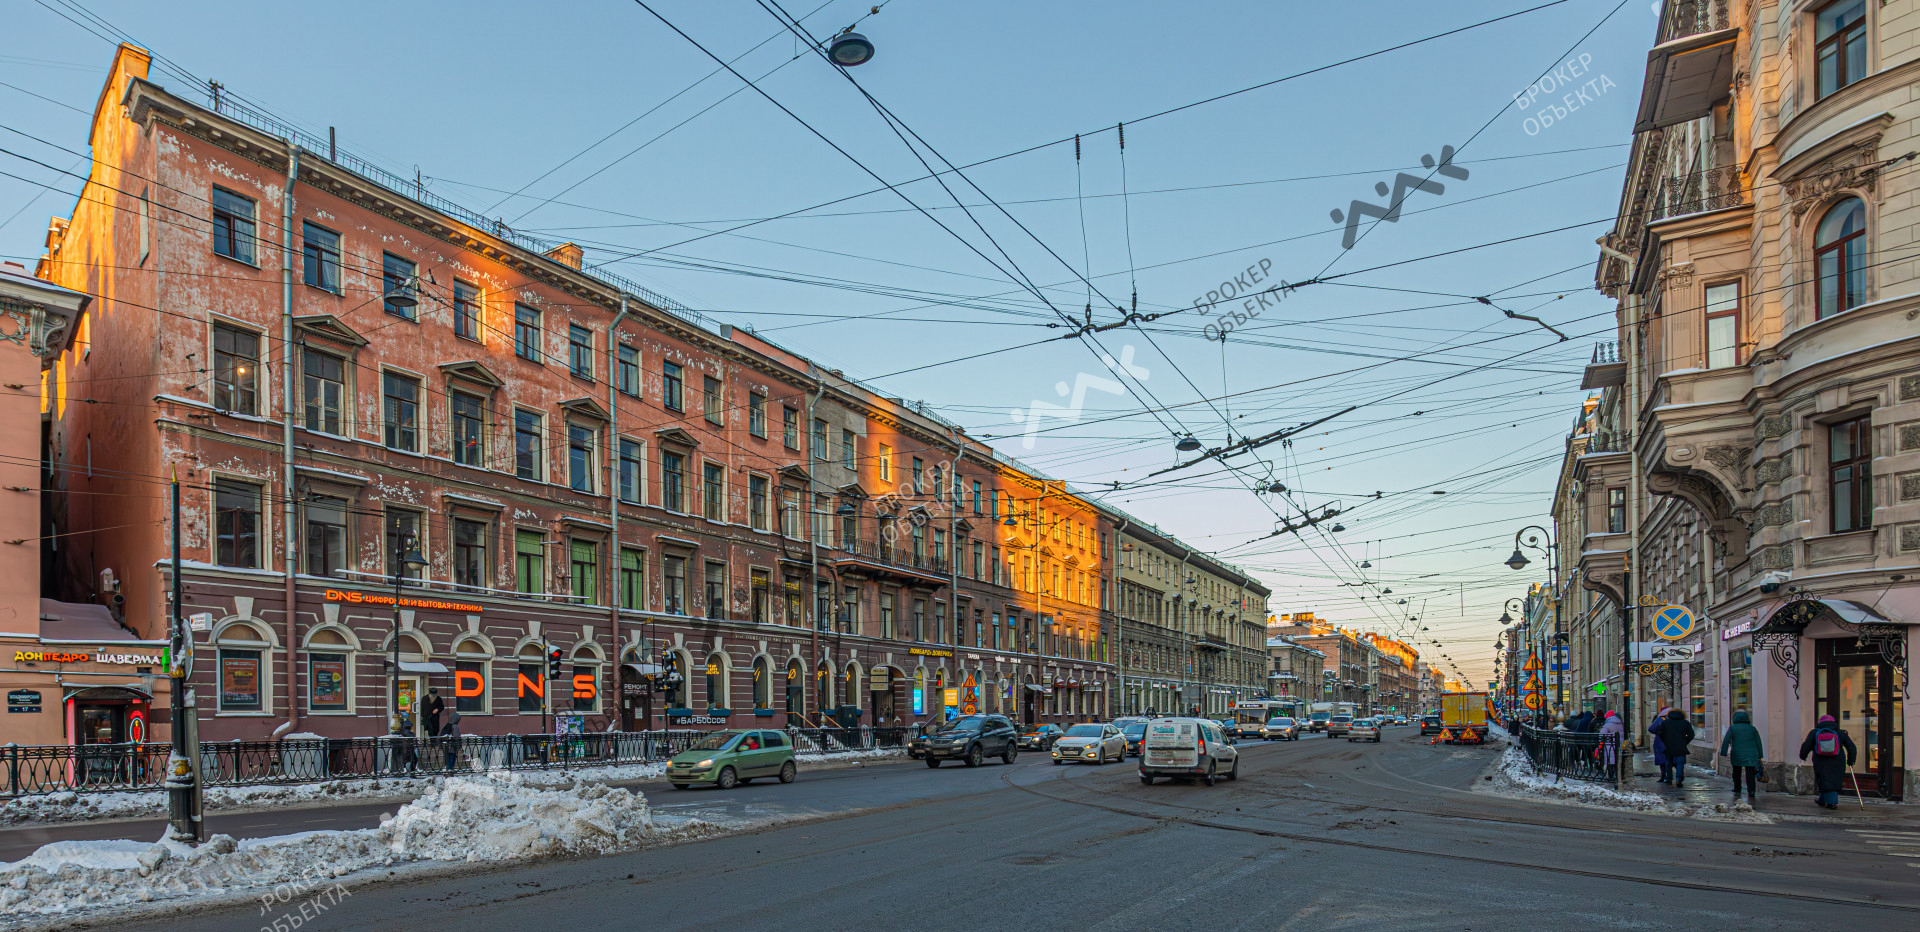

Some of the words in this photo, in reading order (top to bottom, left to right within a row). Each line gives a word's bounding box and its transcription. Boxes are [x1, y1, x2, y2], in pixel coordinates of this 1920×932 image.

[325, 589, 363, 603] DNS
[417, 600, 451, 610] БЫТОВАЯ
[452, 604, 483, 612] ТЕХНИКА
[96, 653, 161, 665] ШАВЕРМА
